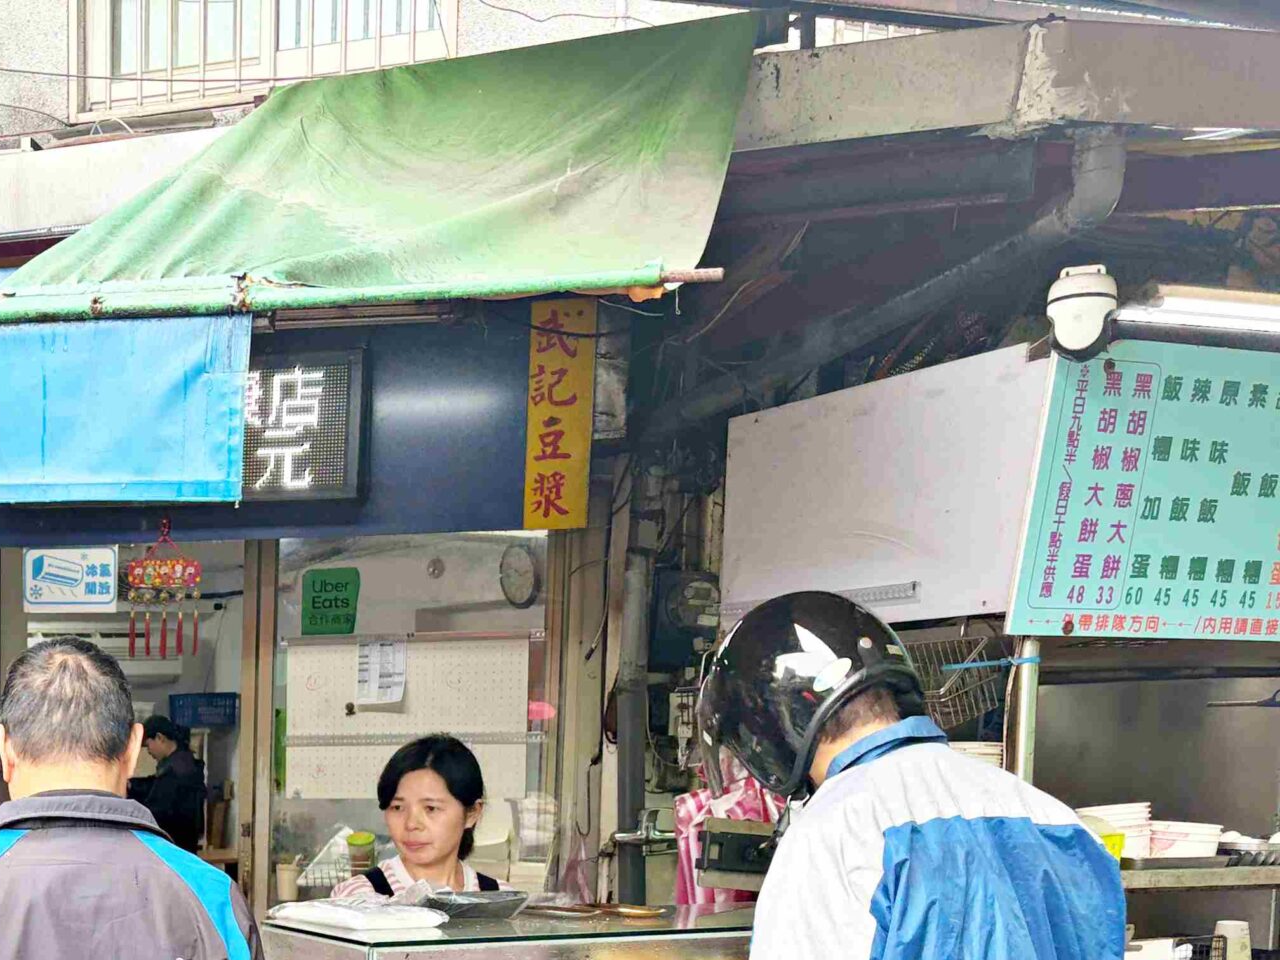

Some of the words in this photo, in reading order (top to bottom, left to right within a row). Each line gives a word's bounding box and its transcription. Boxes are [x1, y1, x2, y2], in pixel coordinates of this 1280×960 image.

[530, 309, 578, 518] 武記豆漿
[1071, 371, 1123, 579] 黑胡椒大餅蛋
[1129, 374, 1184, 579] 飯糰加蛋
[1242, 391, 1280, 585] 飯糰
[312, 579, 350, 593] Uber
[1066, 585, 1086, 604] 48
[1095, 586, 1115, 605] 33
[312, 596, 350, 609] Eats
[1124, 586, 1143, 606] 60
[1153, 587, 1172, 606] 45
[1181, 588, 1200, 607] 45
[1209, 589, 1228, 608] 45
[1238, 590, 1257, 609] 45
